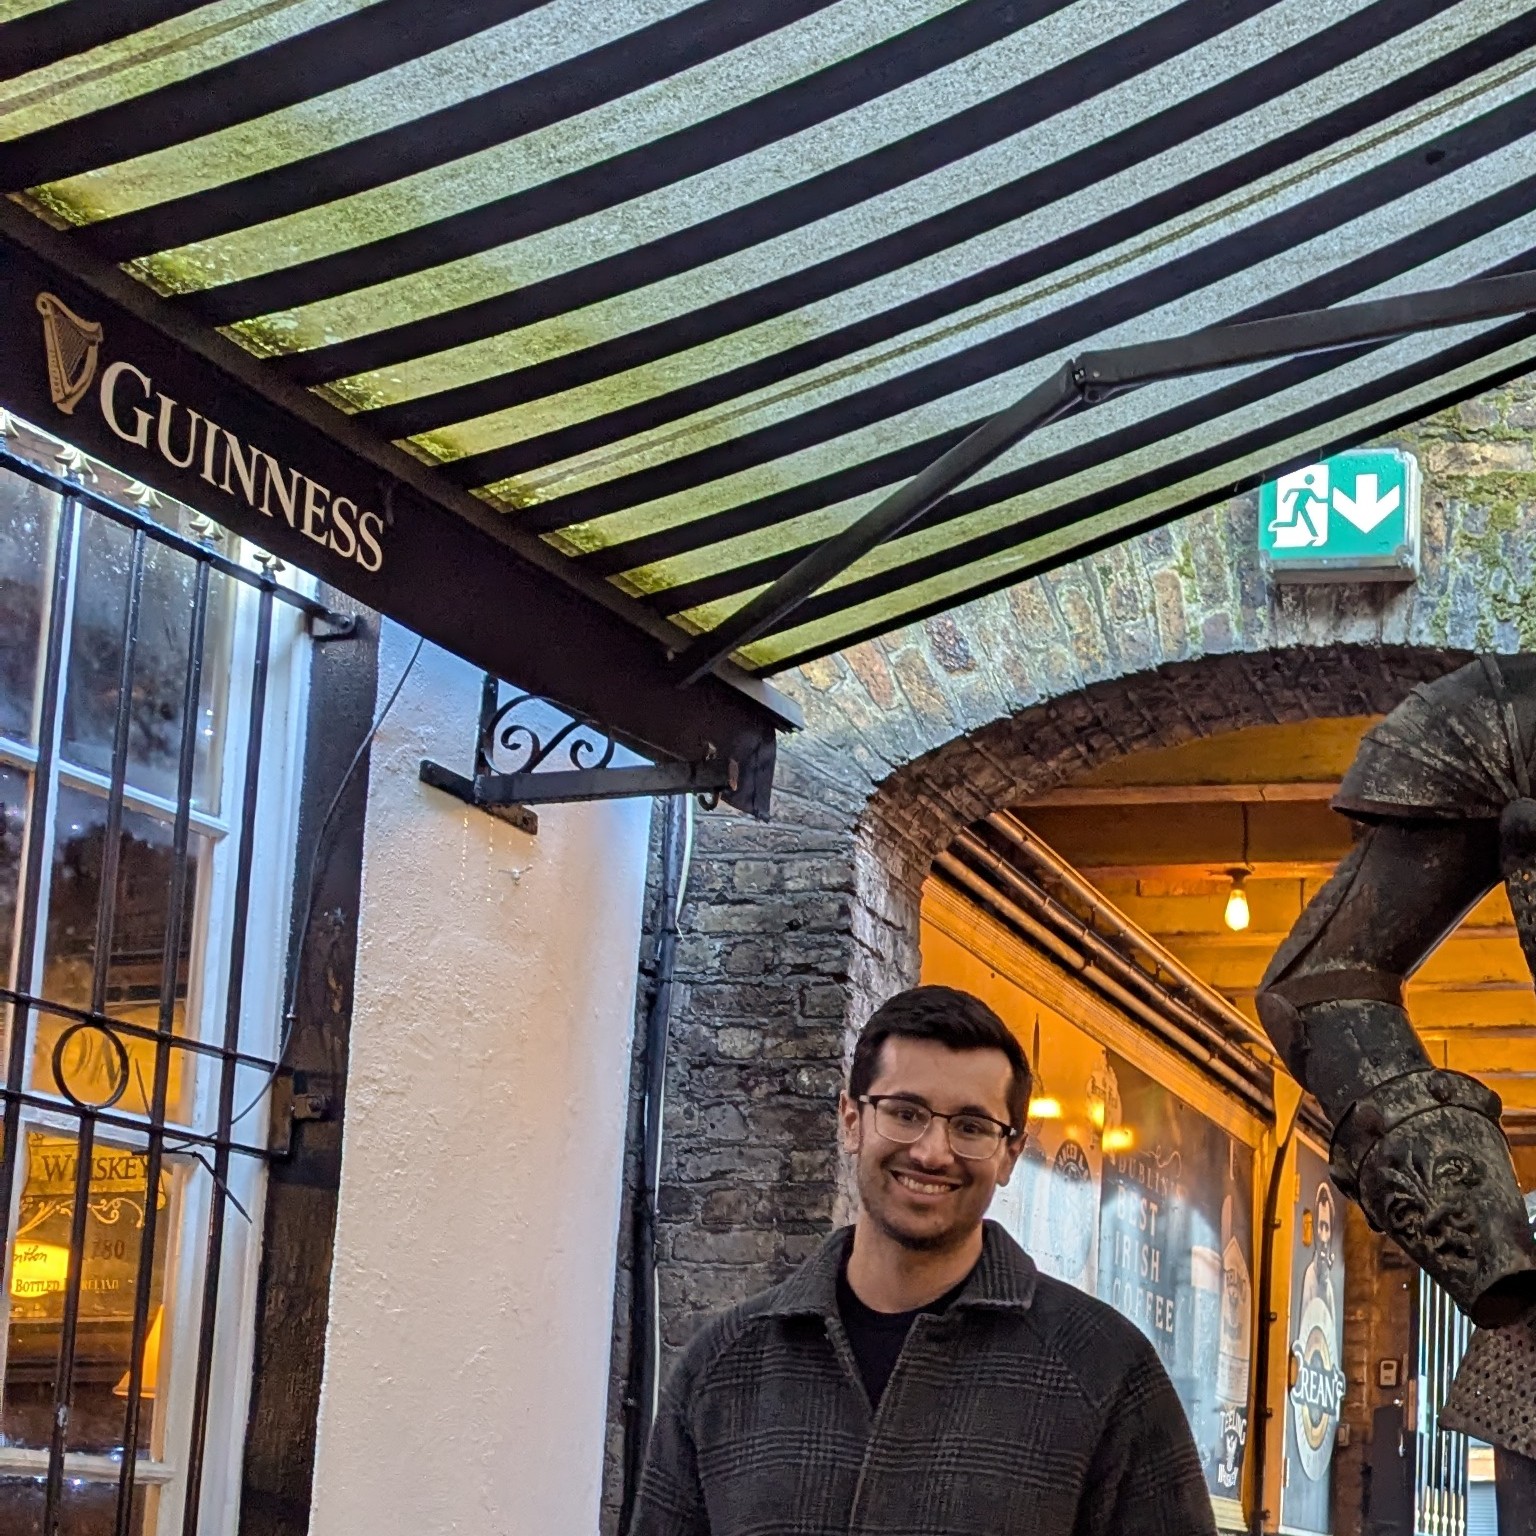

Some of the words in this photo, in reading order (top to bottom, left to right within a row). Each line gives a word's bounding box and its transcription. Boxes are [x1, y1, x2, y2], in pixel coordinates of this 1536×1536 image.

[100, 360, 384, 572] GUINNESS
[41, 1153, 150, 1182] WSKEY
[1116, 1184, 1158, 1237] BEST
[1113, 1230, 1161, 1284] IRISH
[14, 1278, 61, 1292] BOTTLED
[1112, 1277, 1175, 1333] COFFEE
